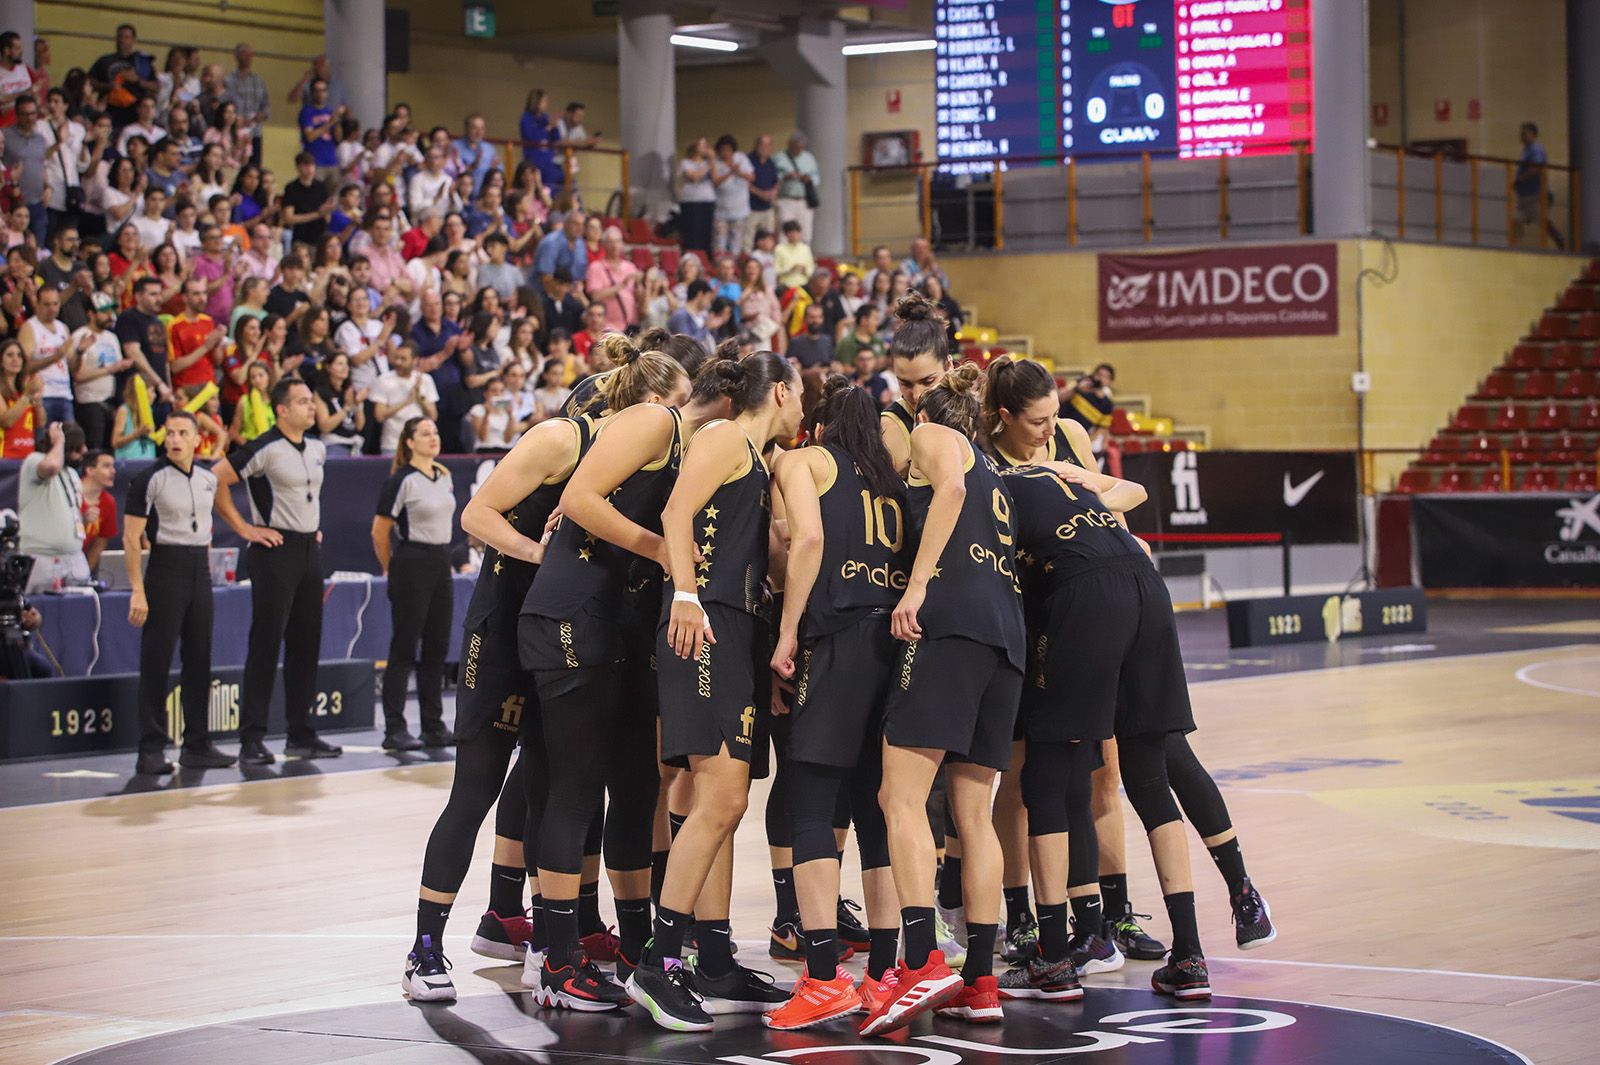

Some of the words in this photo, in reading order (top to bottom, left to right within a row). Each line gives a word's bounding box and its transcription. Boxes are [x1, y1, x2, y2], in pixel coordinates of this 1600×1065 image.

[473, 7, 487, 31] E
[1087, 97, 1107, 123] 0
[1145, 93, 1164, 119] 0
[1157, 263, 1330, 308] IMDECO
[1170, 451, 1201, 511] fi
[861, 489, 904, 554] 10
[992, 488, 1013, 547] 9
[1056, 508, 1118, 540] ende
[841, 560, 908, 590] ende
[465, 633, 482, 690] 1923-2023
[560, 620, 579, 669] 1923-202
[900, 640, 918, 690] 1923-202
[309, 690, 342, 716] 23
[51, 708, 113, 737] 1923
